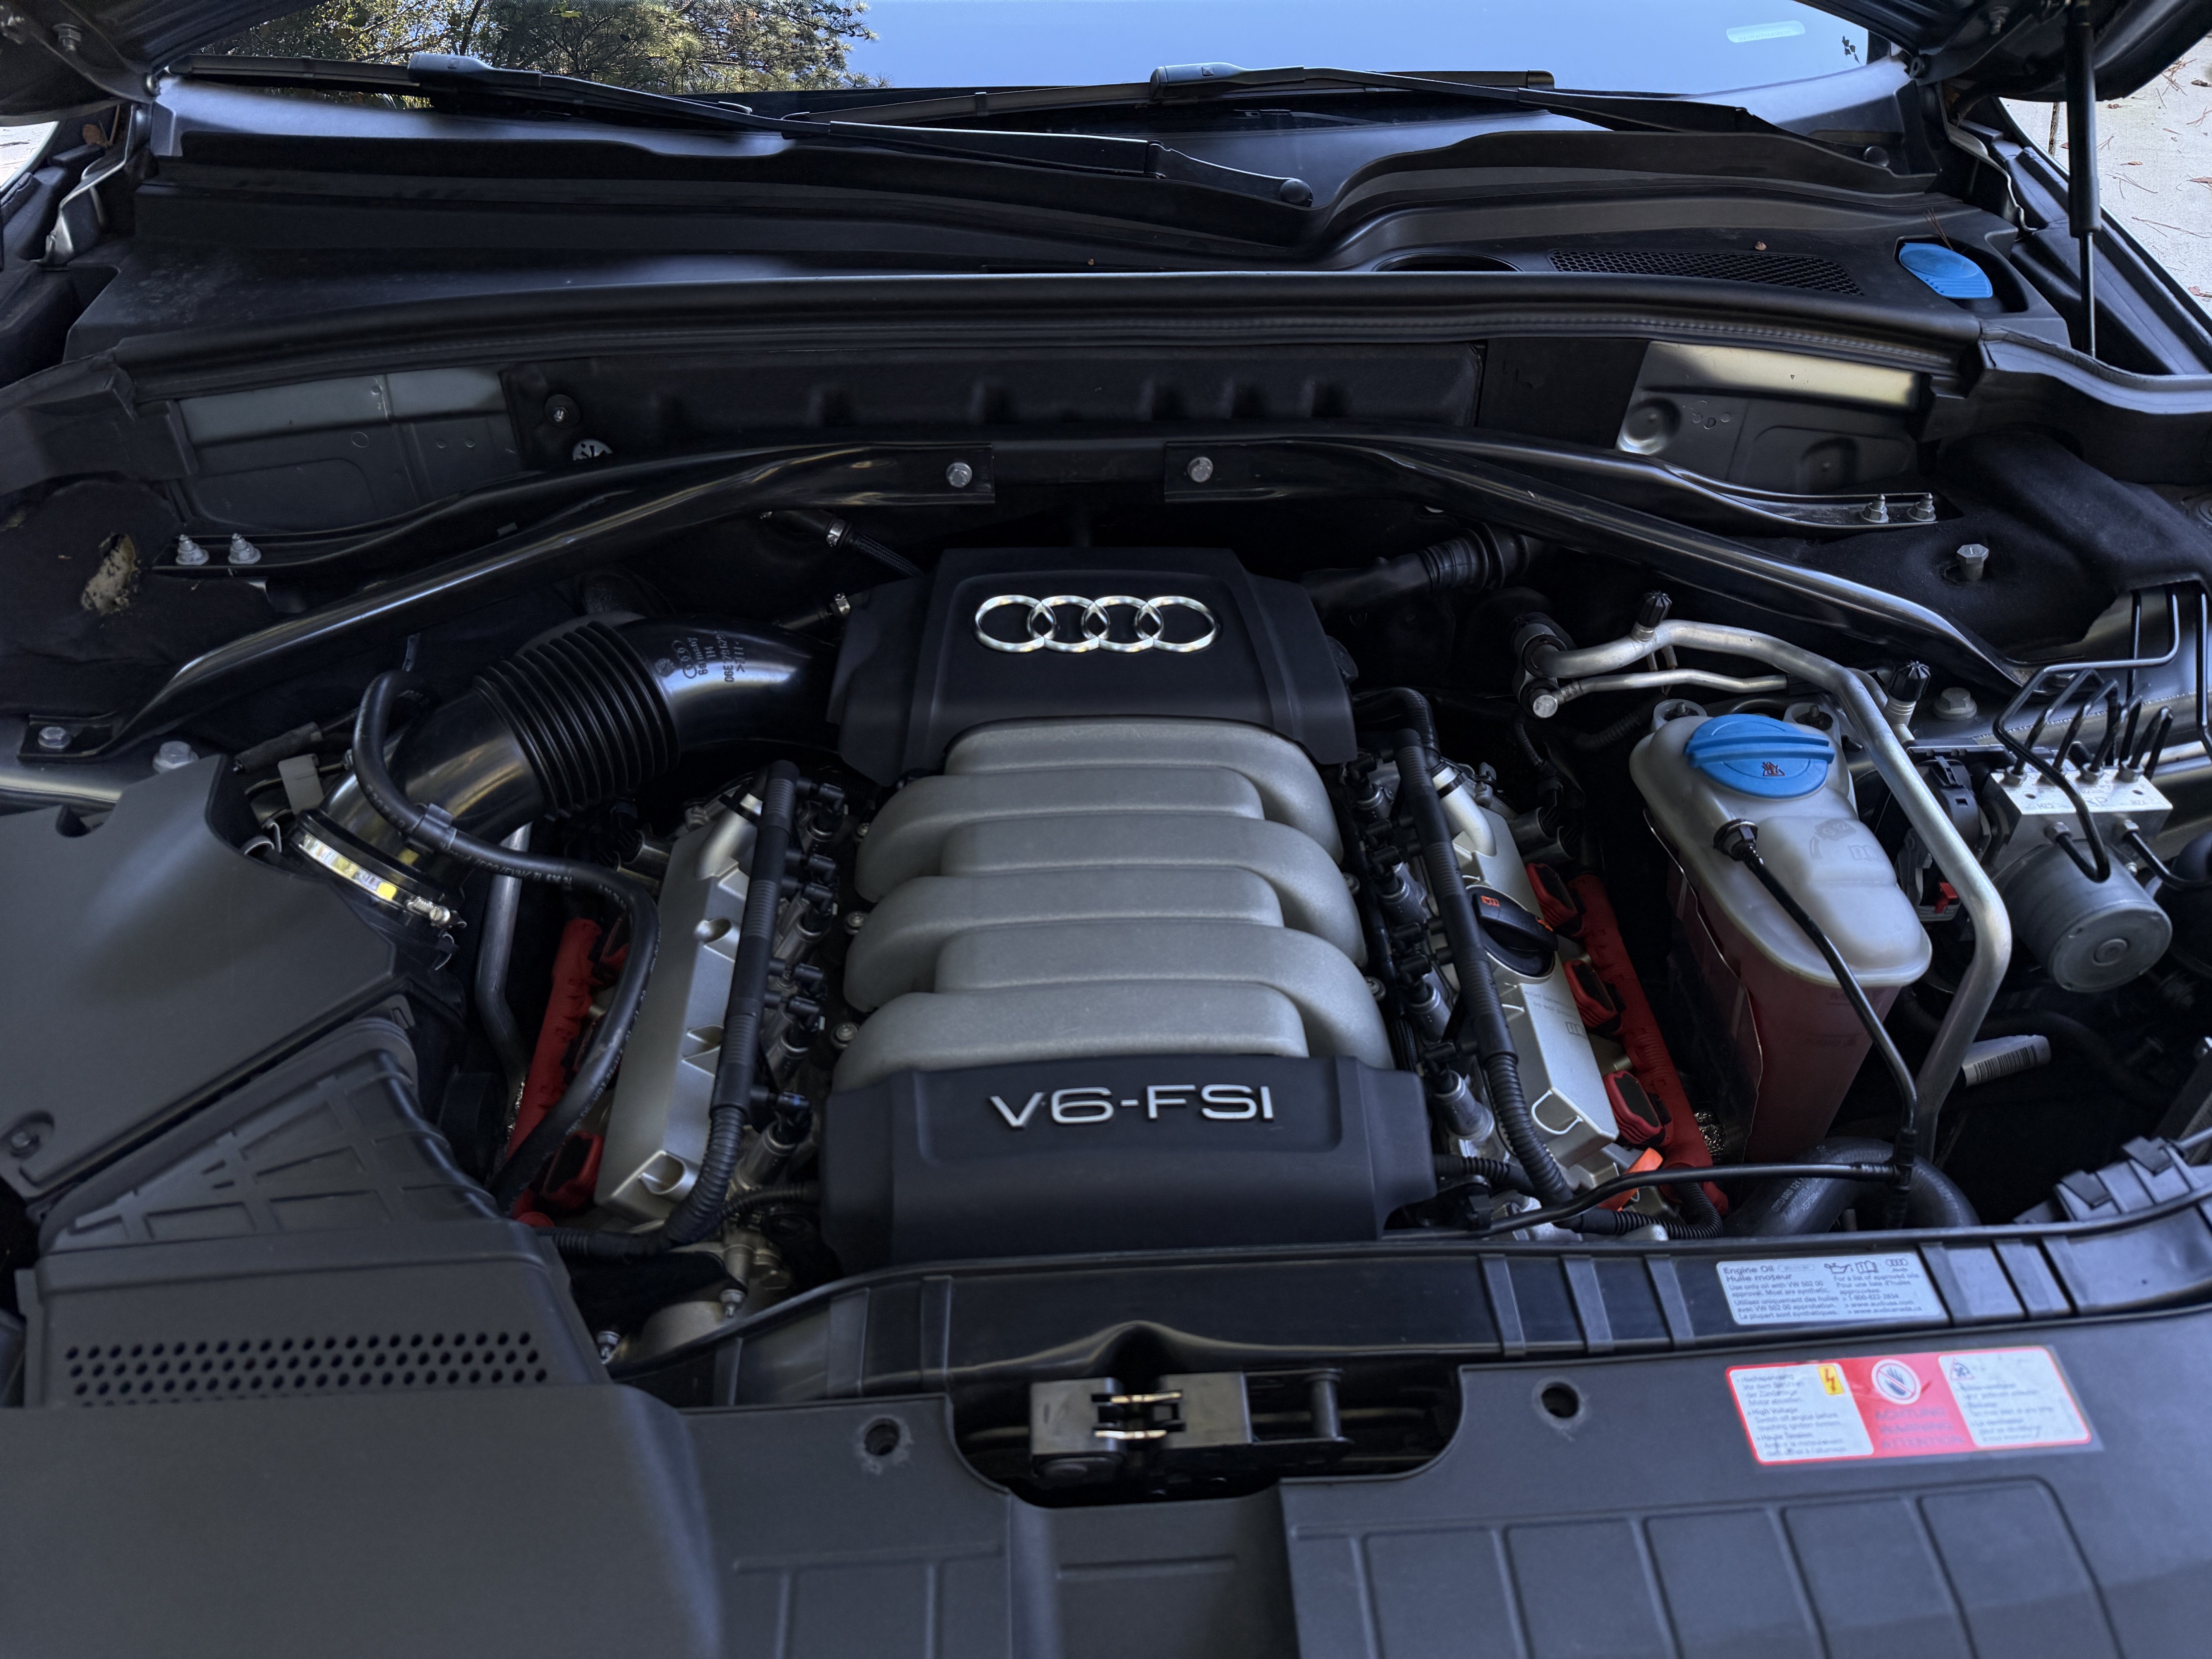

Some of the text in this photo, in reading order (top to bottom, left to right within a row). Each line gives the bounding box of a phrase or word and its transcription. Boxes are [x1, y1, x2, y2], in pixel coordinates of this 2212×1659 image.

[989, 1084, 1274, 1128] V6-FSI
[1723, 1267, 1757, 1276] Engine
[1752, 1407, 1769, 1416] High
